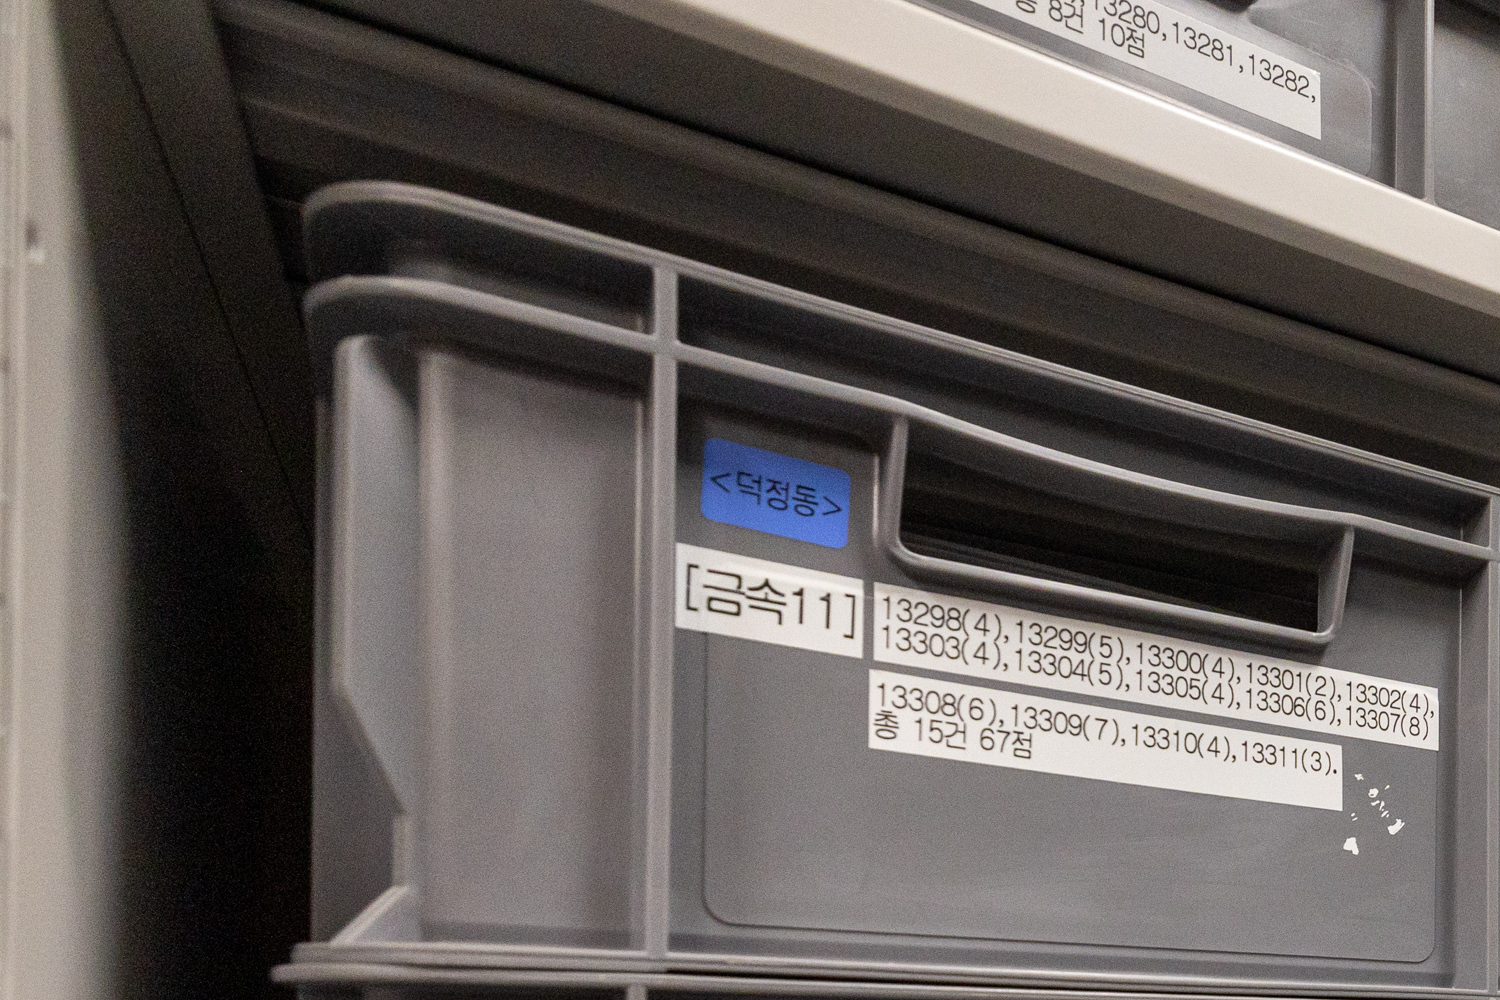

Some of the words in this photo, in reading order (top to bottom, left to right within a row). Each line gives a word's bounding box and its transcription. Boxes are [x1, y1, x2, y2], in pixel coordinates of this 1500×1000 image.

[1099, 18, 1145, 58] 10점
[709, 465, 843, 521] <덕정동>
[684, 563, 856, 640] [금속11]
[873, 709, 900, 742] 총
[914, 717, 967, 751] 15건
[980, 726, 1033, 760] 67점
